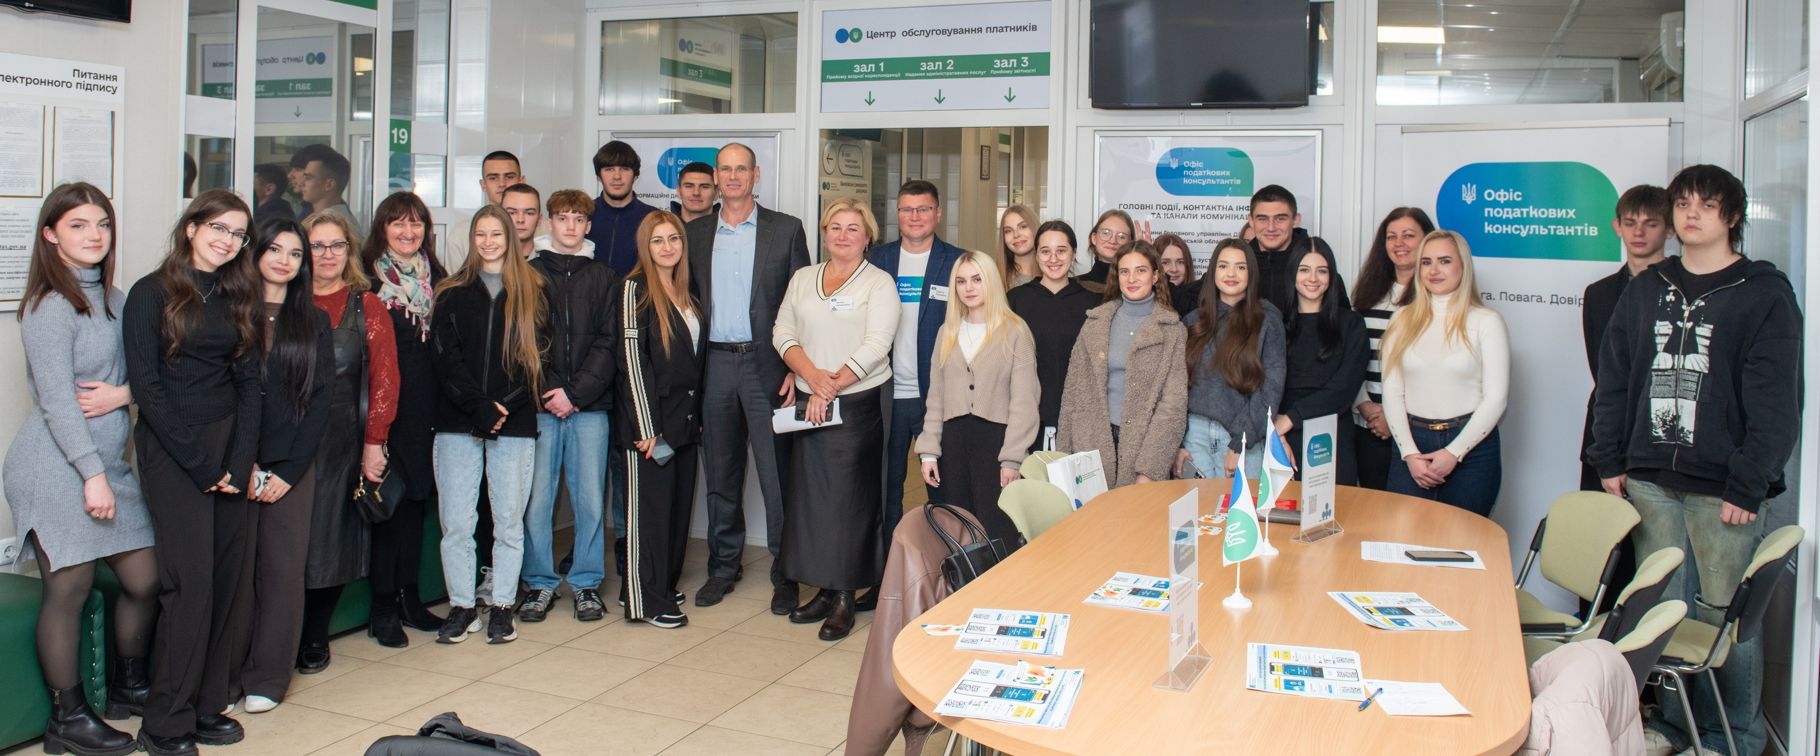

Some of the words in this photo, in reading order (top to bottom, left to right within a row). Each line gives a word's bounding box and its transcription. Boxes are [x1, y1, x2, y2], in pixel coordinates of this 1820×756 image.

[866, 30, 897, 40] Центр
[901, 26, 983, 38] обслуговування
[986, 23, 1038, 33] платників
[853, 63, 876, 73] зал
[878, 62, 885, 72] 1
[920, 61, 943, 71] зал
[946, 60, 954, 70] 2
[993, 58, 1017, 68] зал
[1021, 57, 1029, 67] 3
[72, 68, 118, 82] Питання
[75, 81, 118, 95] підпису
[391, 127, 409, 145] 19
[1183, 160, 1204, 169] Офіс
[1183, 169, 1231, 177] податкових
[1183, 177, 1241, 186] консультантів
[1483, 188, 1523, 204] Офіс
[1118, 203, 1154, 211] ГОЛОВНІ
[1155, 203, 1181, 212] ПОДІЇ,
[1183, 204, 1234, 212] КОНТАКТНА
[1483, 205, 1577, 220] податкових
[1151, 212, 1162, 220] ТА
[1163, 212, 1198, 220] КАНАЛИ
[1484, 222, 1599, 238] консультантів
[1499, 291, 1547, 304] Повага.
